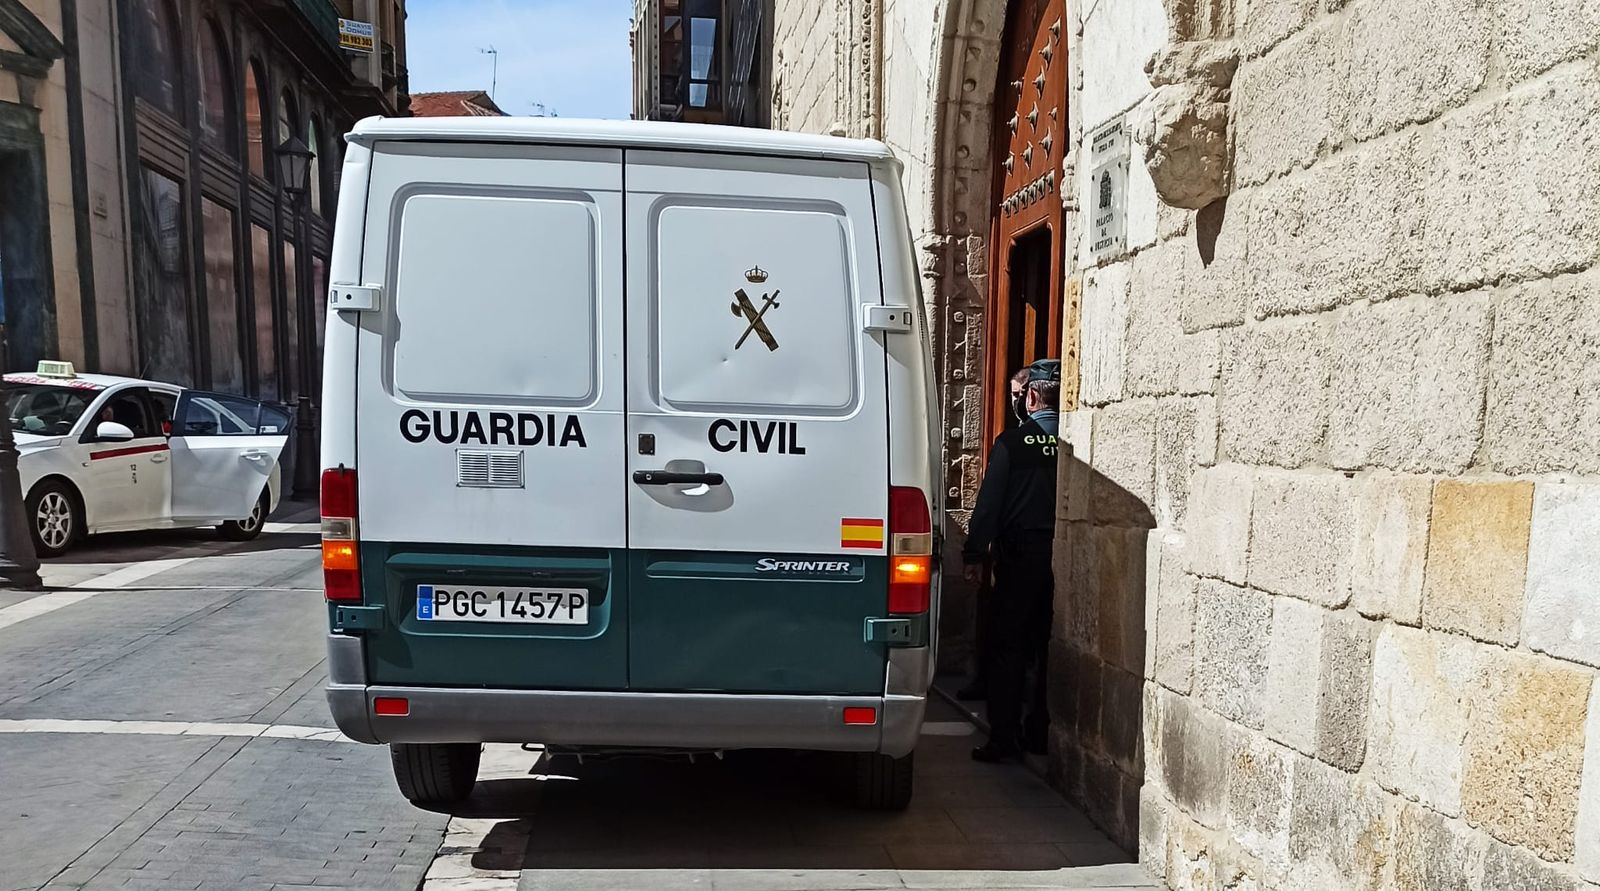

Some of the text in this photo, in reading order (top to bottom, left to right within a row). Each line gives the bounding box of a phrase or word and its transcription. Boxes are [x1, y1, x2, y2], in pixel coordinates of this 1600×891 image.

[346, 21, 372, 30] SUAVIS
[346, 27, 372, 36] DOMUS
[400, 409, 806, 455] GUARDIA CIVIL
[1043, 446, 1059, 455] CI
[755, 558, 850, 571] SPRINTER
[422, 606, 430, 614] E
[435, 590, 487, 617] PGC
